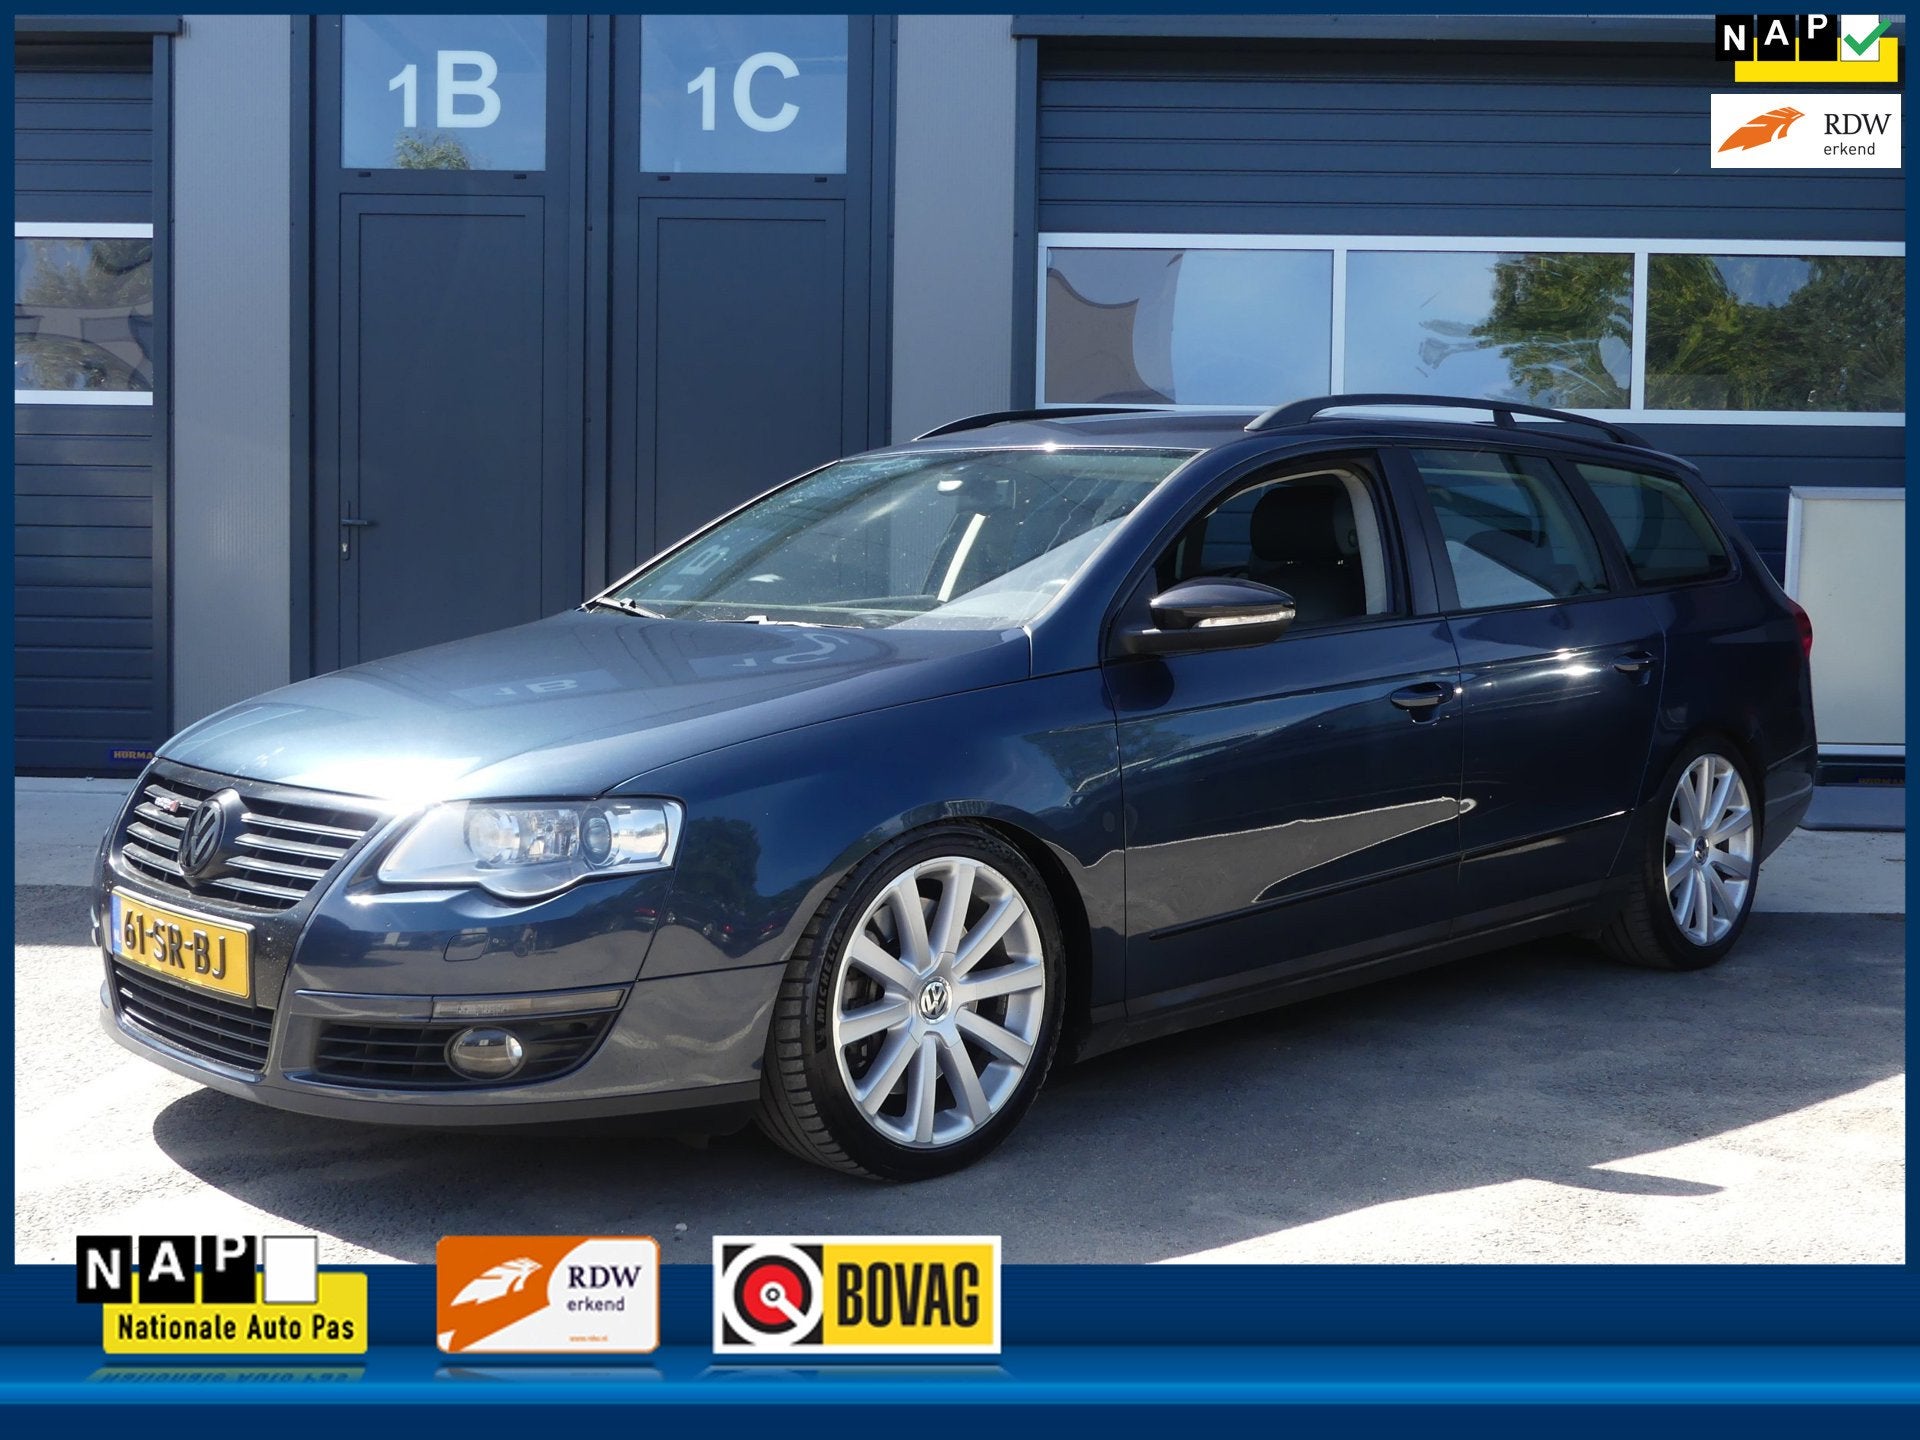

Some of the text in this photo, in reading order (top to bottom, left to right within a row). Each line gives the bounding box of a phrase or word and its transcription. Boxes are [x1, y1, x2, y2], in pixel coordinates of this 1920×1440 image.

[388, 50, 501, 129] 1B
[687, 52, 800, 132] 1C
[124, 908, 226, 981] 61-SR-BJ
